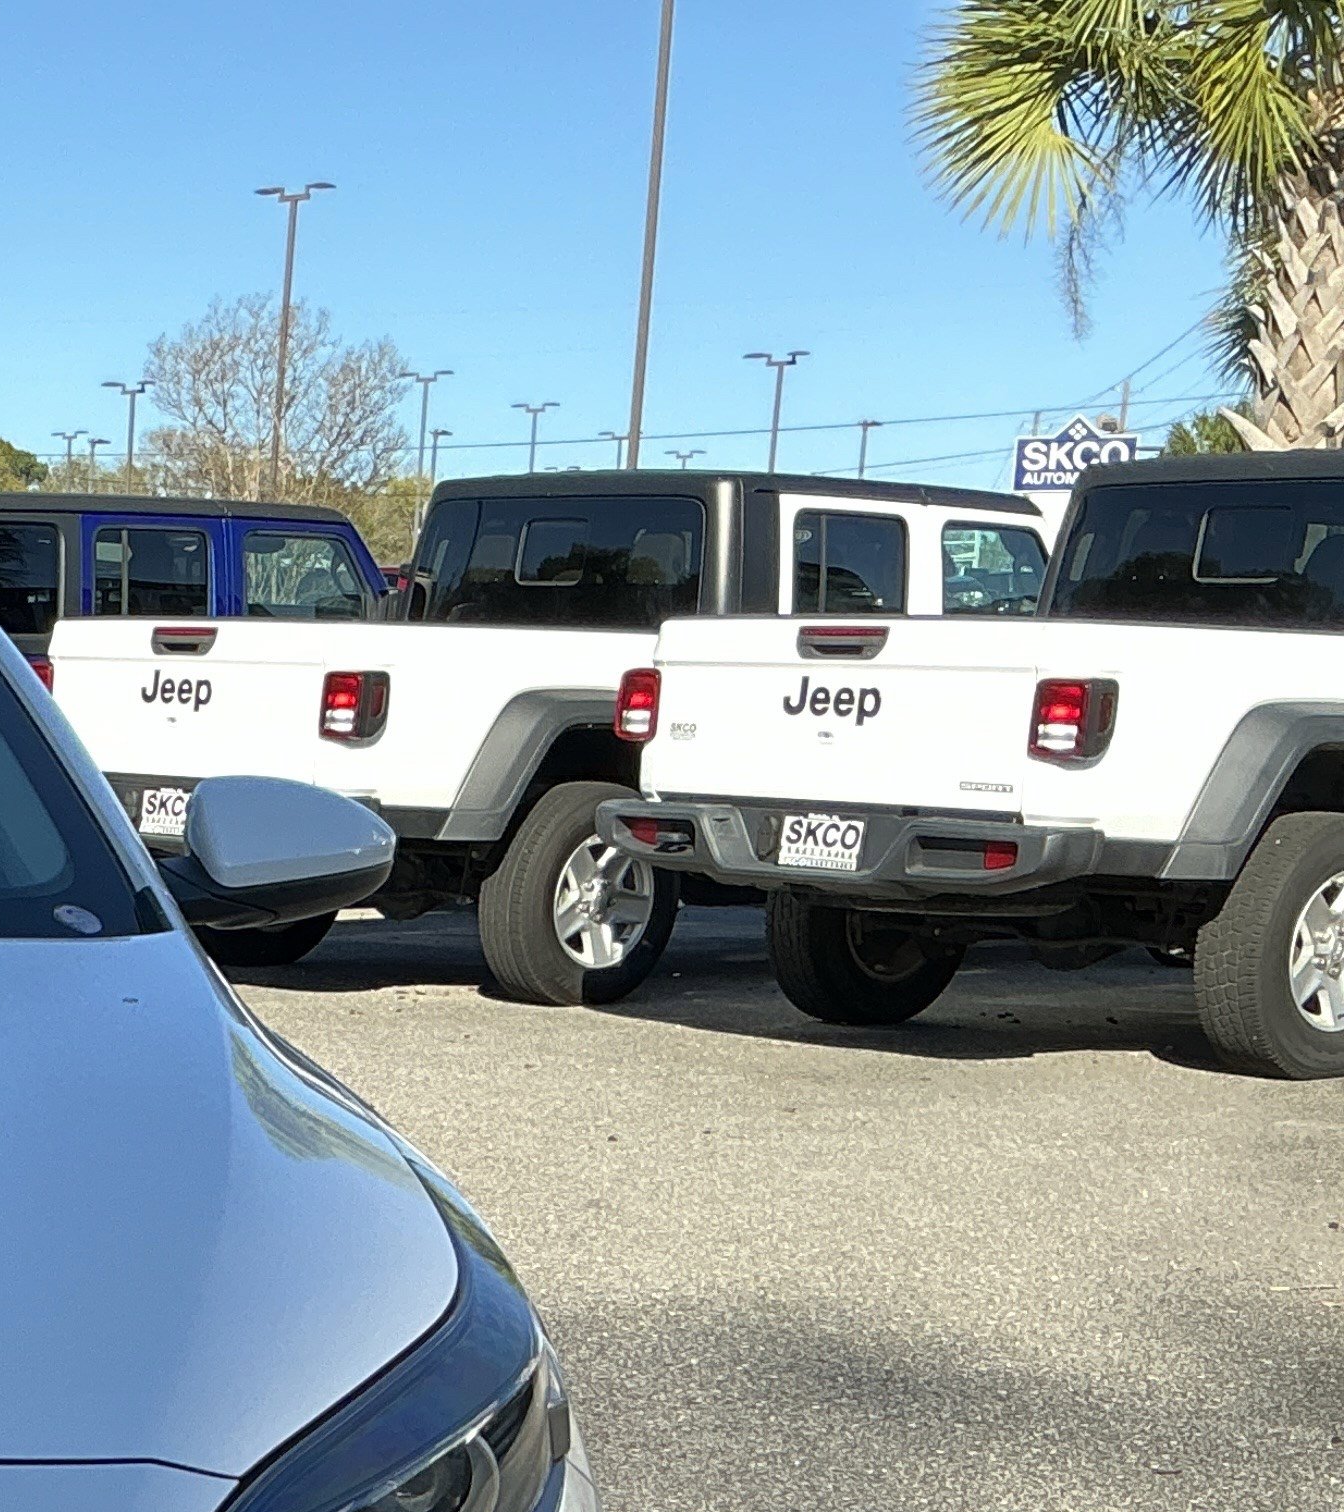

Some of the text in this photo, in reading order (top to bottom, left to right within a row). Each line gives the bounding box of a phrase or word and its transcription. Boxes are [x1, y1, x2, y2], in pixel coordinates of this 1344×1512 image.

[1021, 439, 1130, 471] SKCO
[141, 669, 212, 712] Jeep
[783, 675, 882, 726] Jeep
[145, 792, 192, 817] SKC
[785, 819, 860, 850] SKCO
